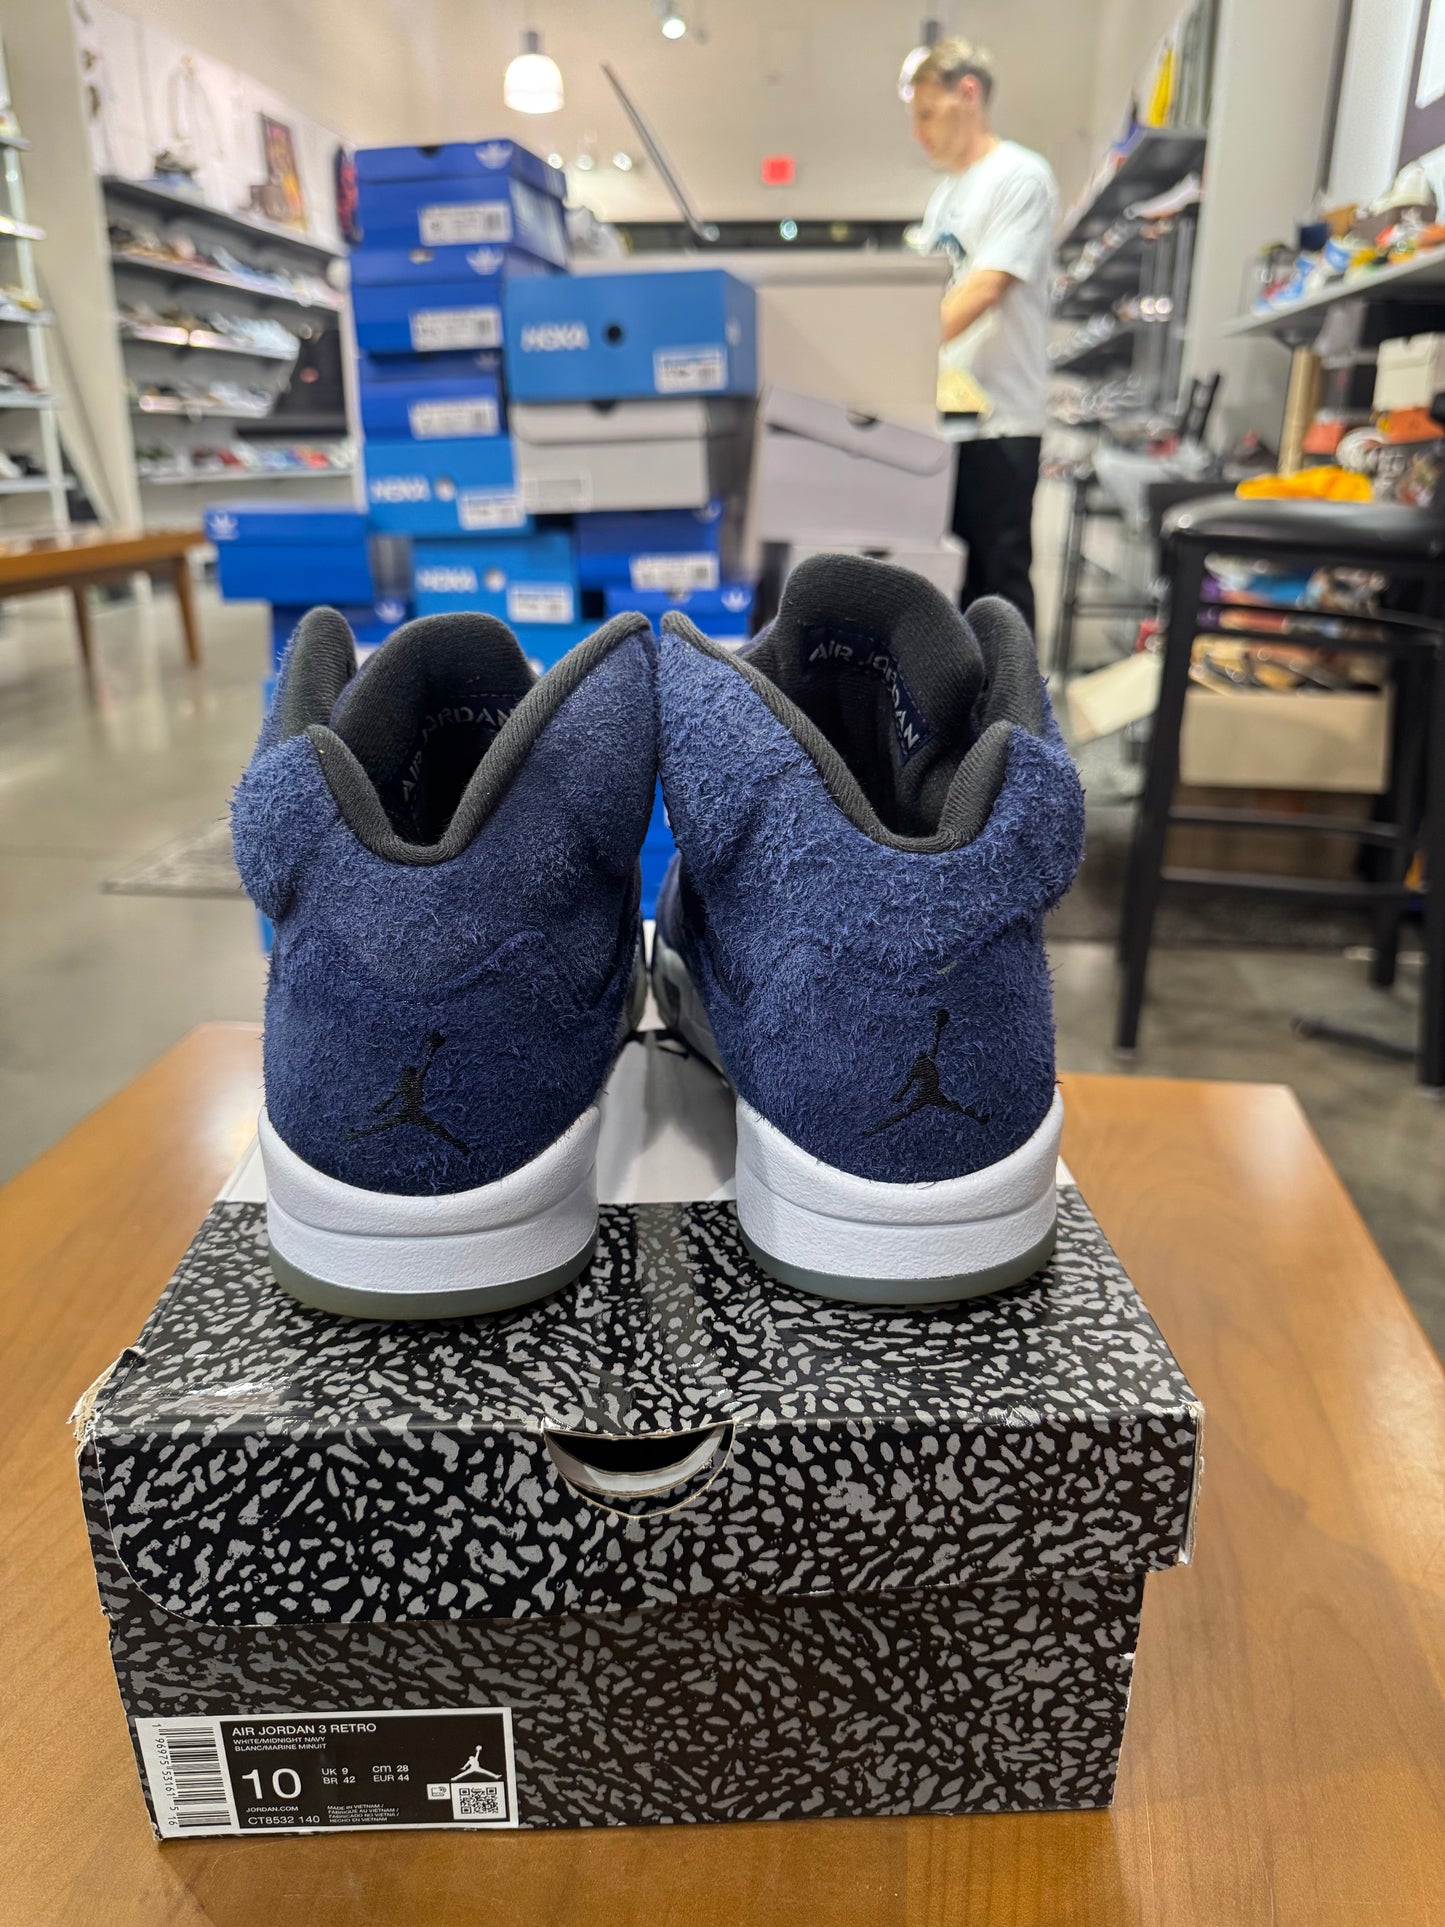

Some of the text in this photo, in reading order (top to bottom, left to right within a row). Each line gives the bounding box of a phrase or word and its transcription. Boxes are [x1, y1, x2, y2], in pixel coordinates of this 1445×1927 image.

[808, 640, 853, 662] AIR
[232, 1722, 377, 1736] AIR JORDAN 3 RETRO
[233, 1737, 302, 1745] WHITE/MIDNIGHT
[234, 1744, 297, 1752] BLANC/MARINE
[155, 1737, 169, 1766] 96975
[162, 1770, 176, 1796] 53161
[321, 1767, 349, 1776] UK 9
[372, 1764, 409, 1773] cm 28
[242, 1768, 302, 1799] 10
[322, 1775, 356, 1785] BR 42
[373, 1774, 410, 1783] EUR 44
[248, 1815, 320, 1825] CT8532 140
